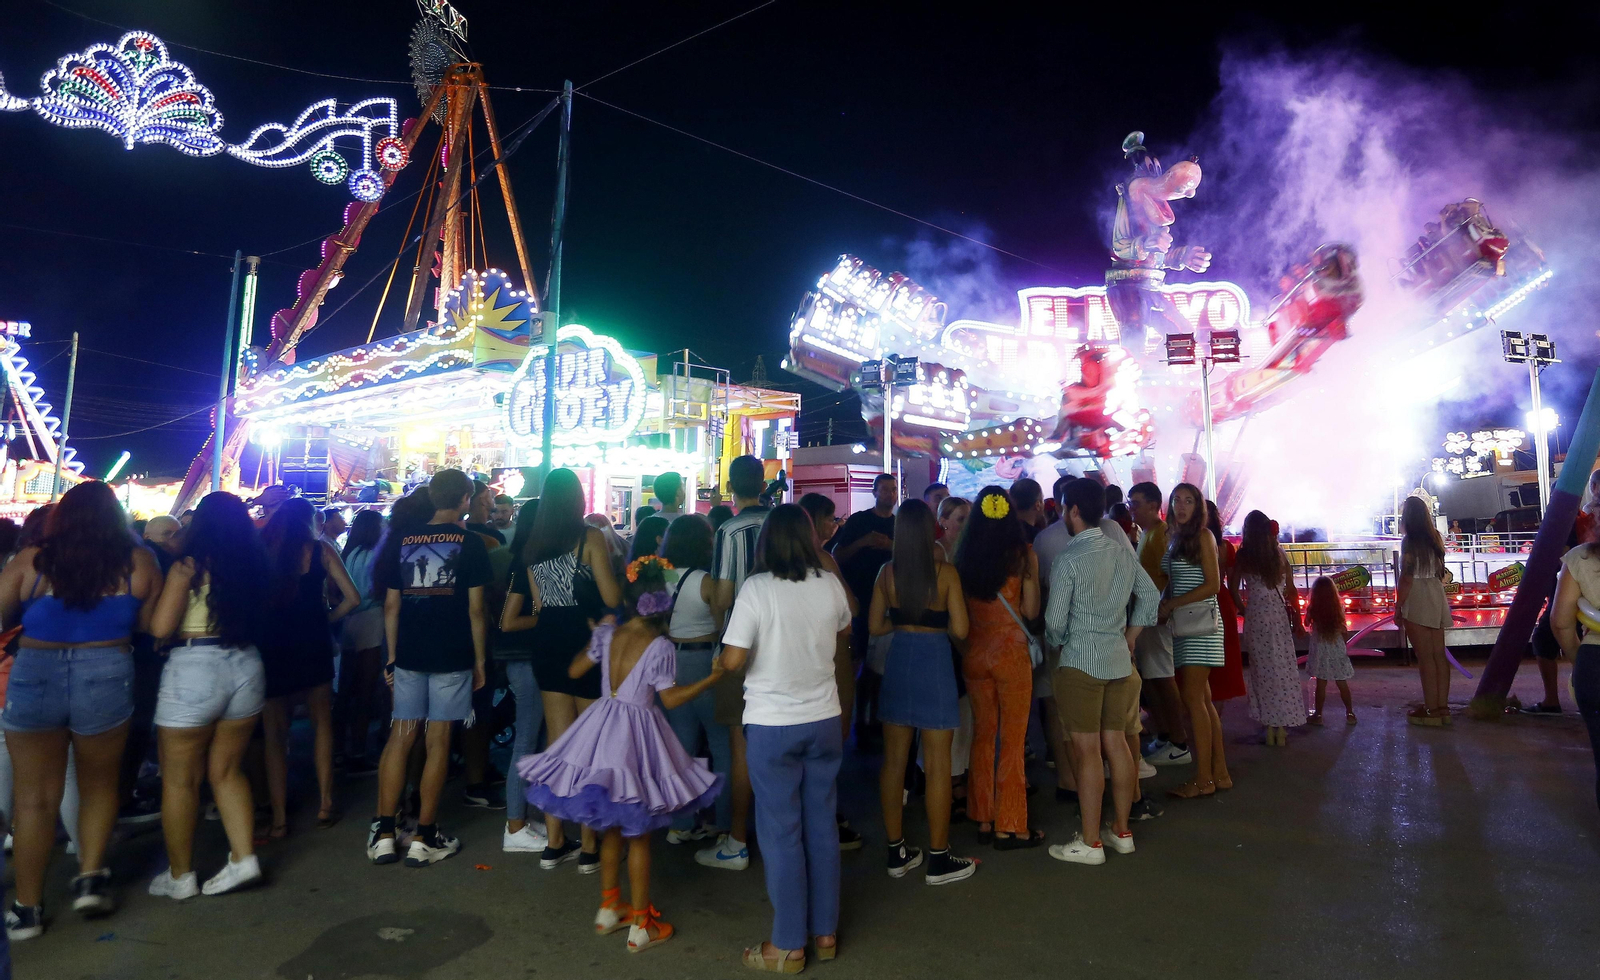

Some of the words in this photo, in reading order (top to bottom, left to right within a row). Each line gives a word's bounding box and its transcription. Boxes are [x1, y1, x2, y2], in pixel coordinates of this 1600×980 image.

[1029, 297, 1079, 340] EL
[402, 533, 464, 545] DOWNTOWN
[1499, 575, 1521, 588] Altura
